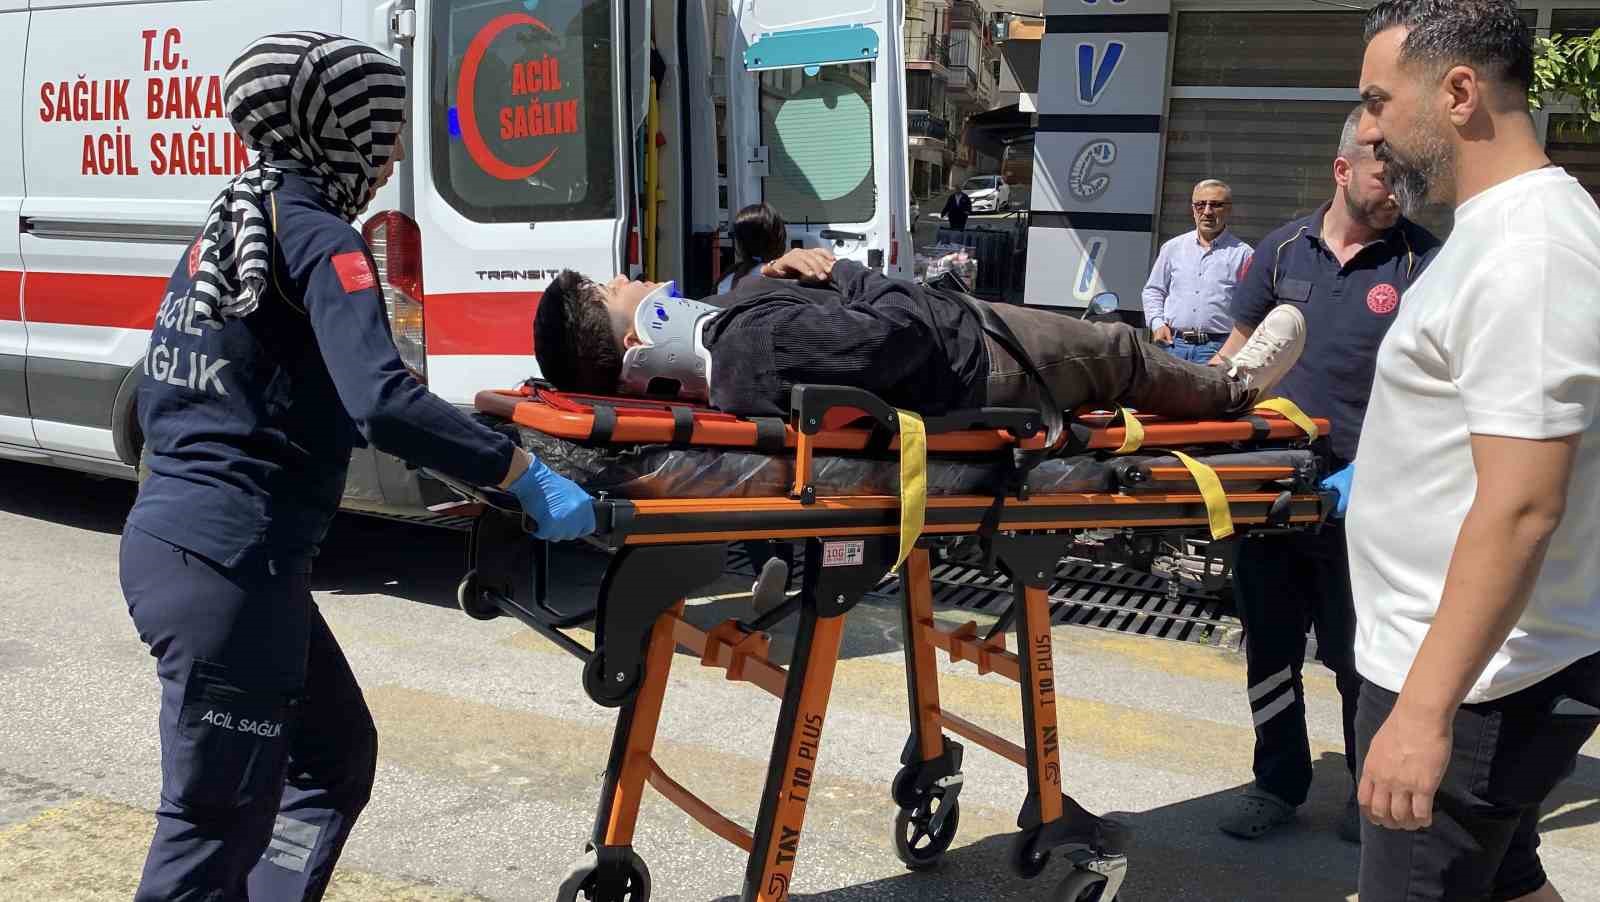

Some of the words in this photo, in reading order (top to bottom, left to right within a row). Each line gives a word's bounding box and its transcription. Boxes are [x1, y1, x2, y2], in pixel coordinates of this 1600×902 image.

[142, 28, 188, 71] T.C.
[511, 53, 561, 96] ACİL
[40, 73, 130, 122] SAĞLIK
[147, 76, 231, 119] BAKA
[500, 98, 578, 140] SAĞLIK
[81, 126, 139, 176] ACİL
[475, 269, 559, 280] TRANSIT
[1036, 633, 1053, 672] PLUS
[201, 710, 234, 729] ACİL
[776, 826, 799, 866] TAY
[799, 713, 823, 761] PLUS
